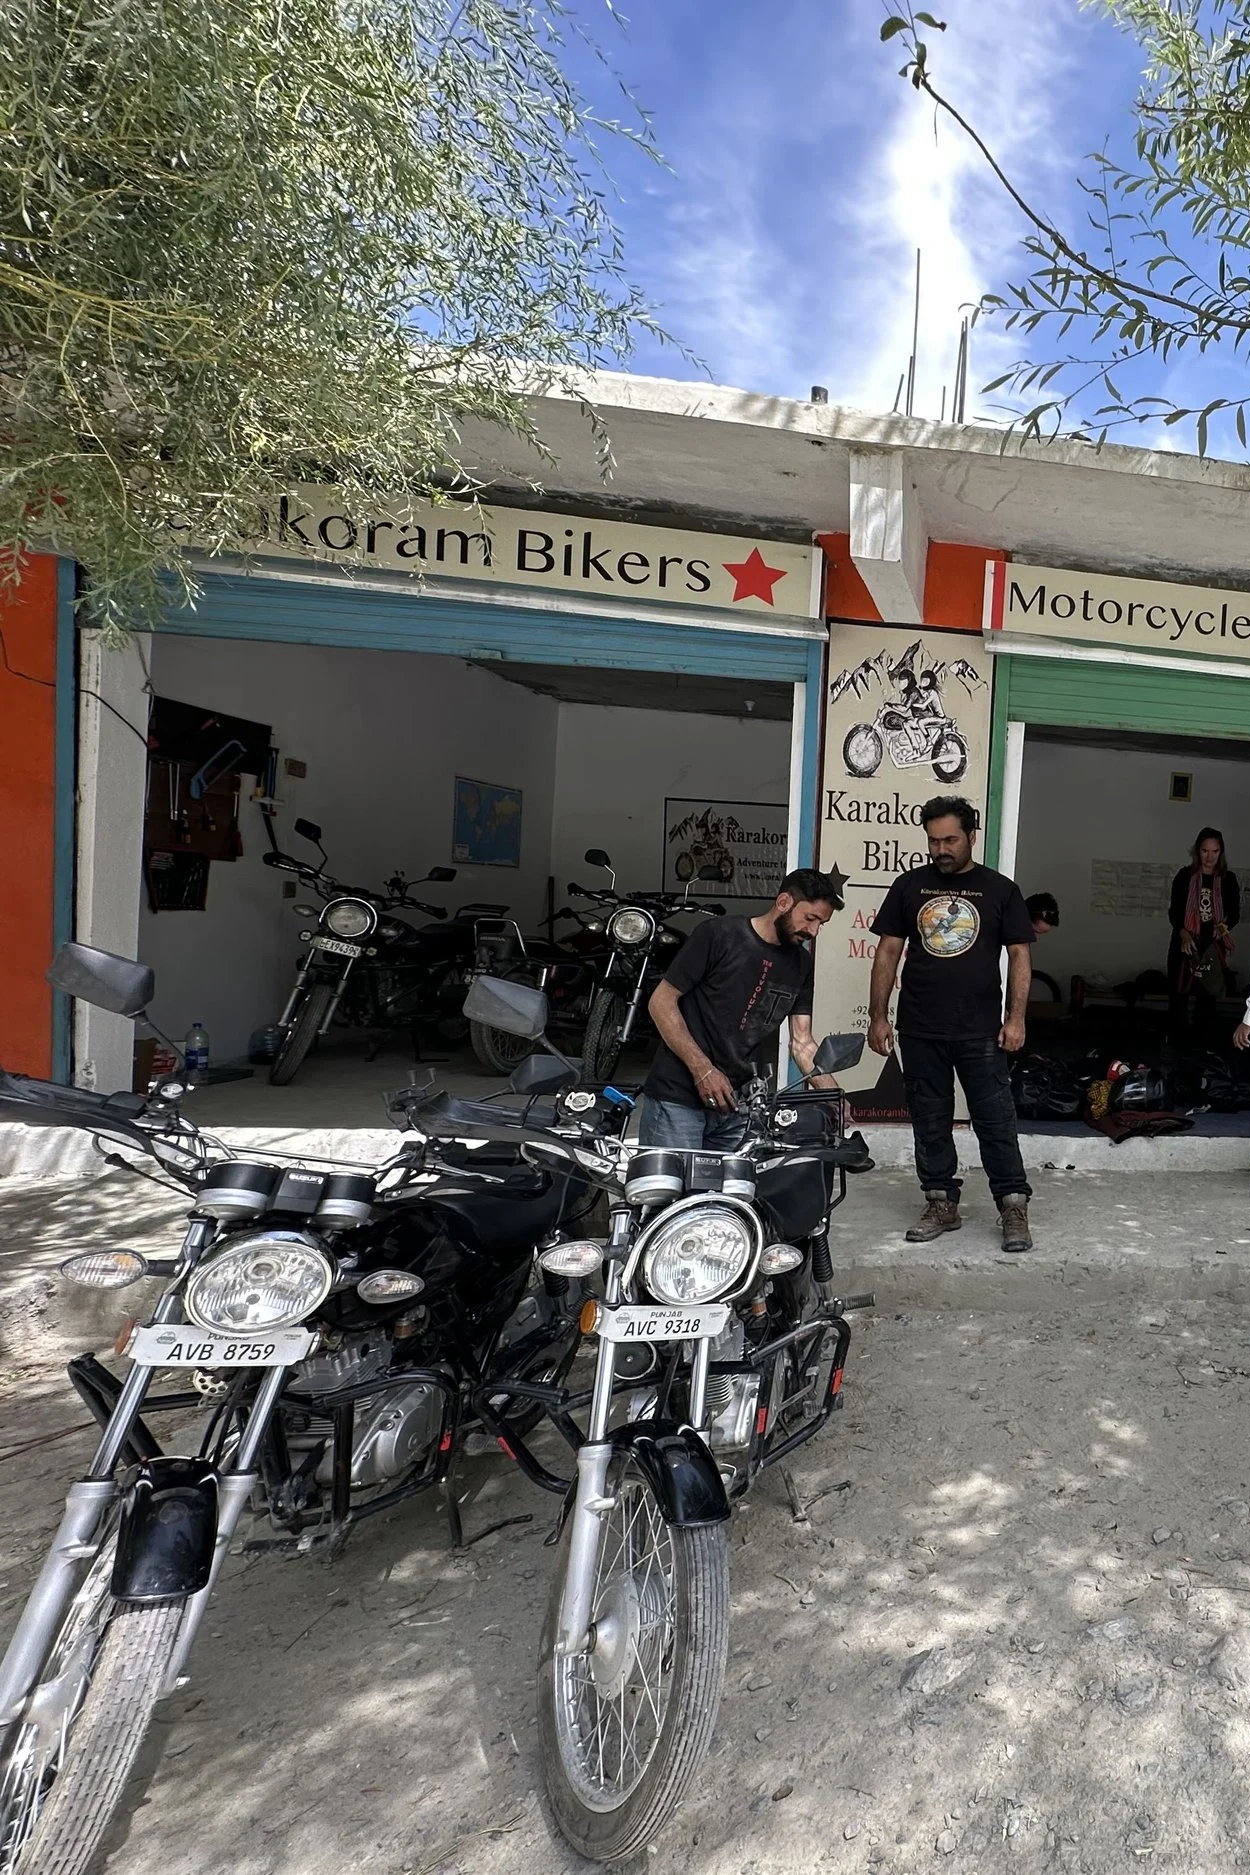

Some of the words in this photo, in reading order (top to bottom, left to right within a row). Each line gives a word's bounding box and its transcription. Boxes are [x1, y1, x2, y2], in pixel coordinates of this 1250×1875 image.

[516, 528, 712, 593] Bikers
[650, 1310, 683, 1318] PUNJAB
[624, 1320, 657, 1337] AVC
[664, 1318, 701, 1335] 9318
[166, 1343, 214, 1361] AVB
[223, 1343, 276, 1361] 8759
